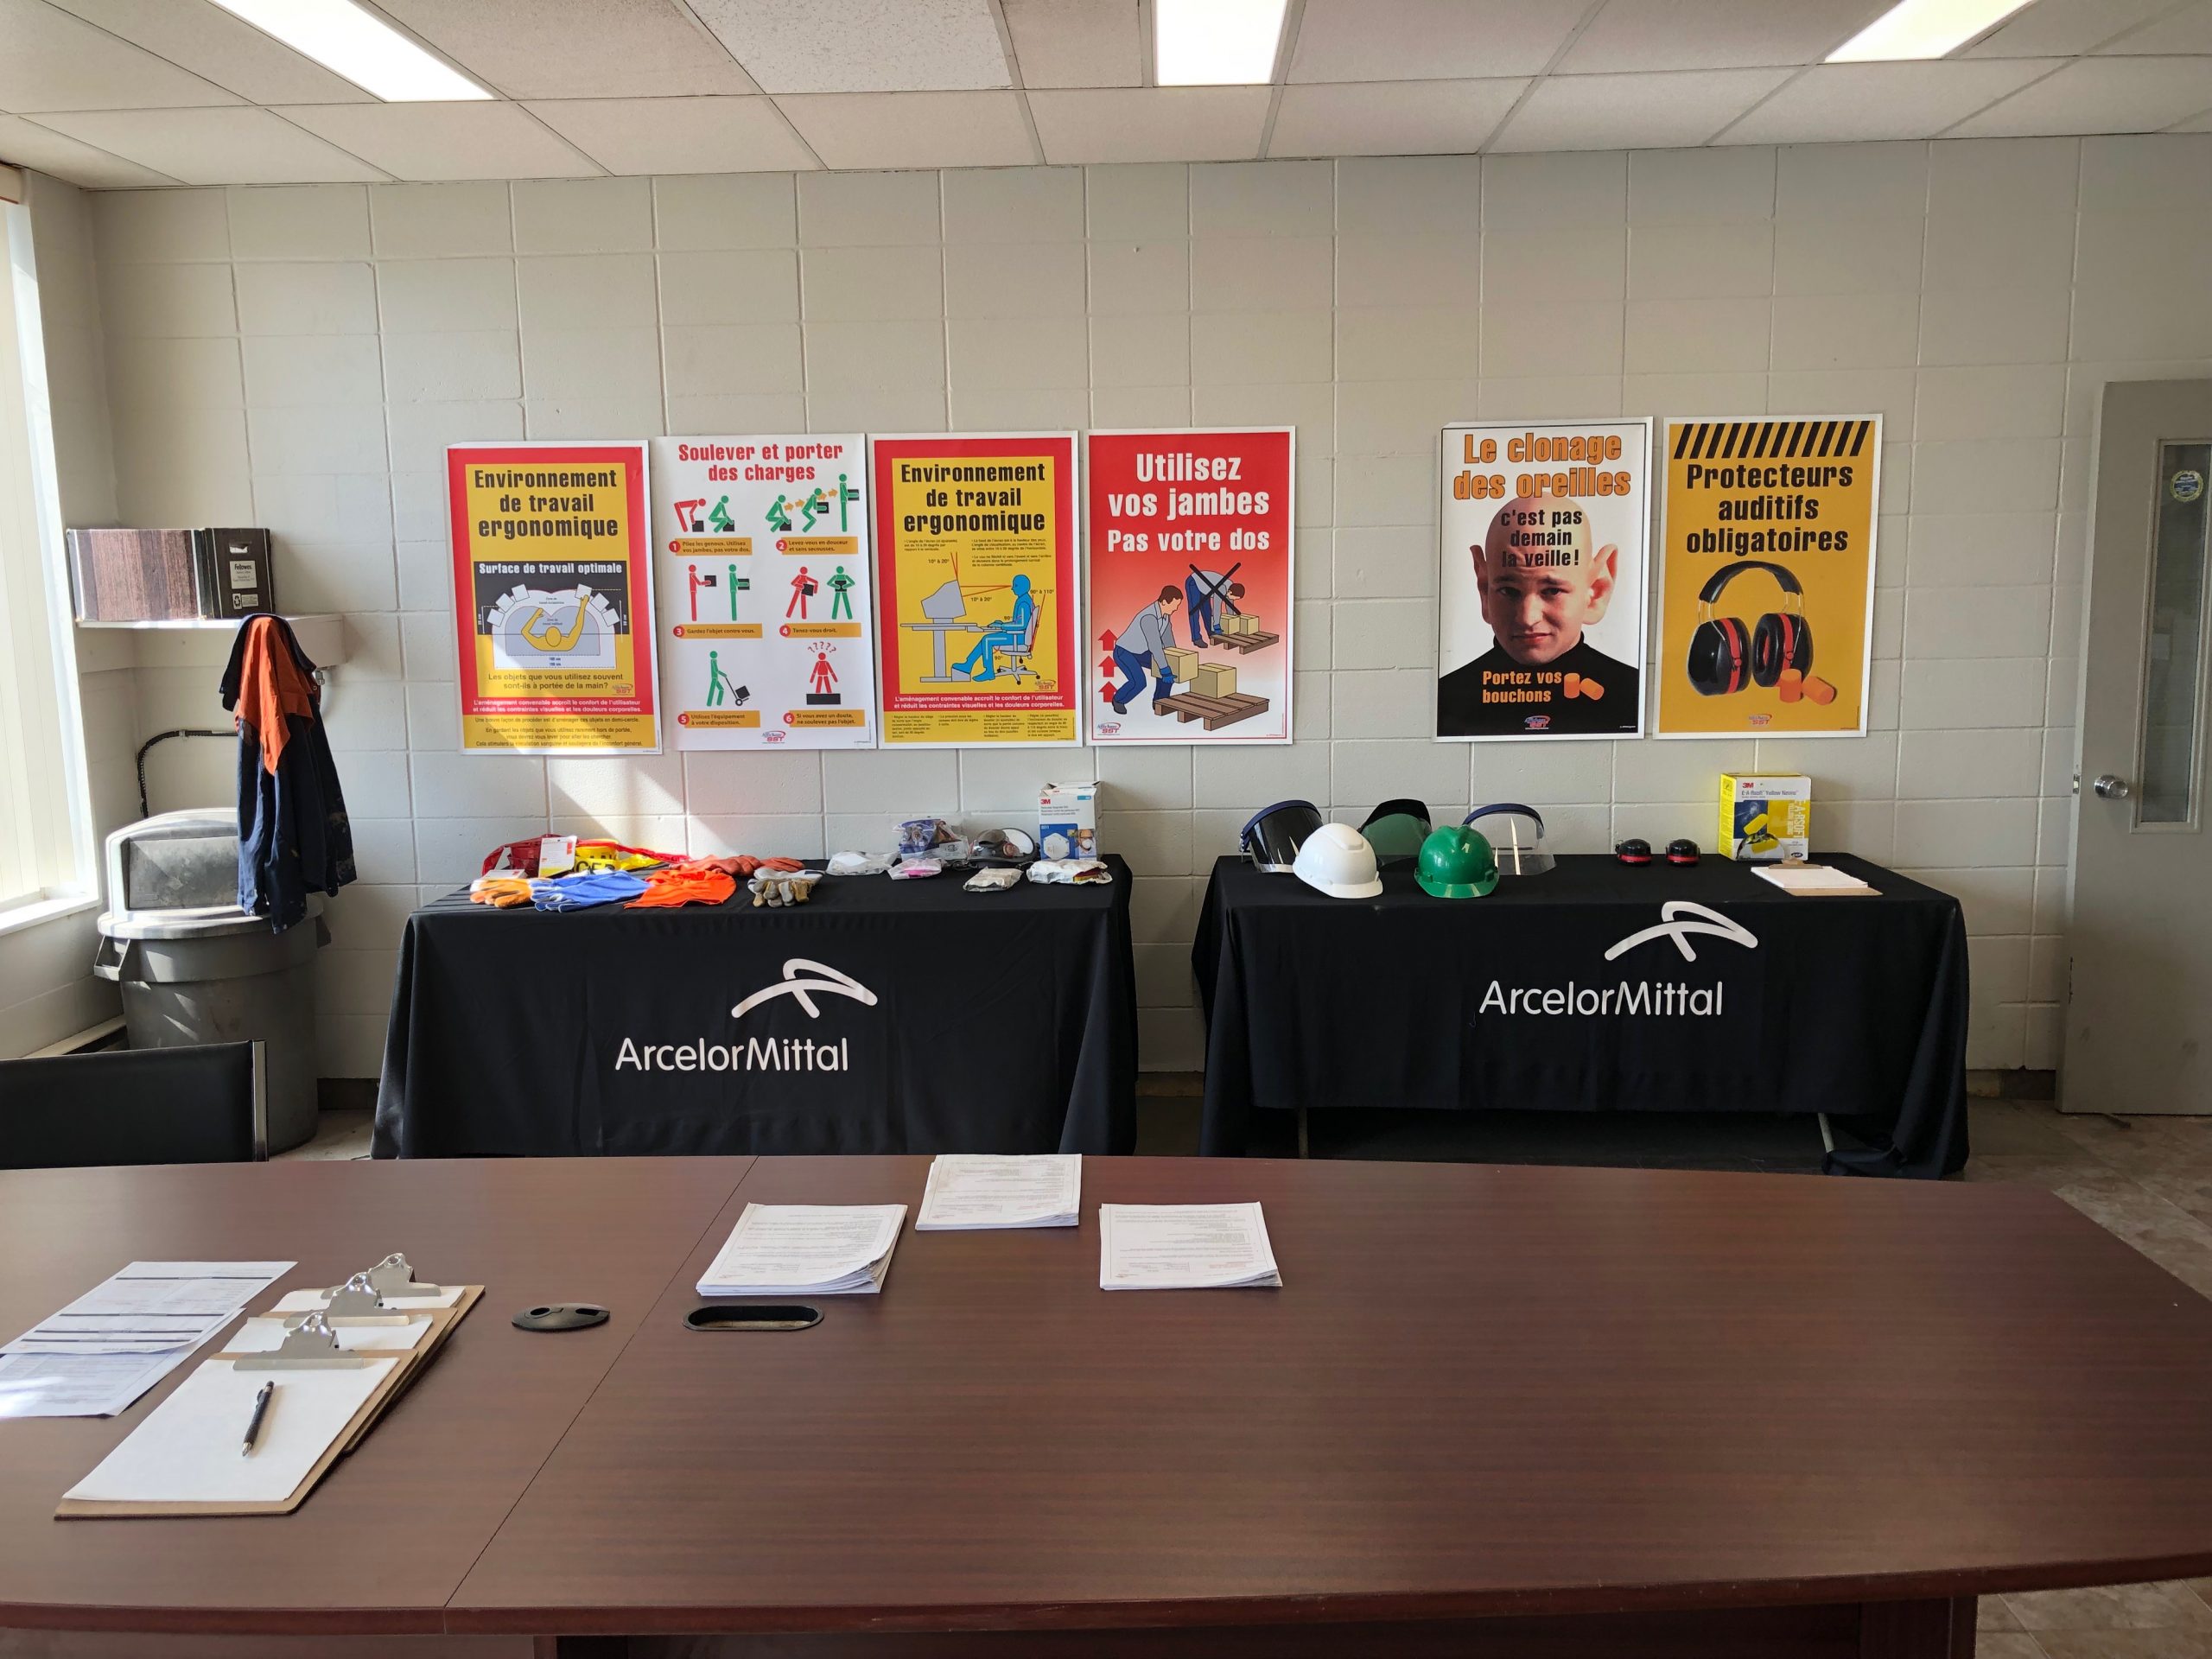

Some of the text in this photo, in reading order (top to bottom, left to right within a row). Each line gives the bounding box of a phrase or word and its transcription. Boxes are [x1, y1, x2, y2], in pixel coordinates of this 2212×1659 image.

[678, 442, 843, 462] Soulever et porter
[1464, 432, 1622, 466] Le clonage
[709, 464, 815, 483] des charges
[901, 463, 1046, 482] Environnement
[1136, 453, 1242, 482] Utilisez
[1687, 463, 1853, 490] Protecteurs
[474, 469, 617, 488] Environnement
[1453, 467, 1631, 500] des oreilles
[499, 493, 594, 512] de travail
[926, 487, 1021, 507] de travail
[1108, 486, 1269, 521] vos jambes
[1719, 494, 1820, 521] auditifs
[479, 516, 619, 540] ergonomique
[904, 511, 1045, 535] ergonomique
[1501, 509, 1583, 528] c'est pas
[1108, 528, 1269, 553] Pas votre dos
[1510, 529, 1572, 547] demain
[1687, 527, 1848, 556] obligatoires
[1501, 550, 1517, 568] la
[479, 563, 622, 576] Surface de travail optimale
[539, 682, 563, 690] portée
[1483, 671, 1562, 685] Portez vos
[1483, 689, 1552, 703] bouchons
[1478, 980, 1723, 1016] ArcelorMittal
[615, 1037, 849, 1071] ArcelorMittal
